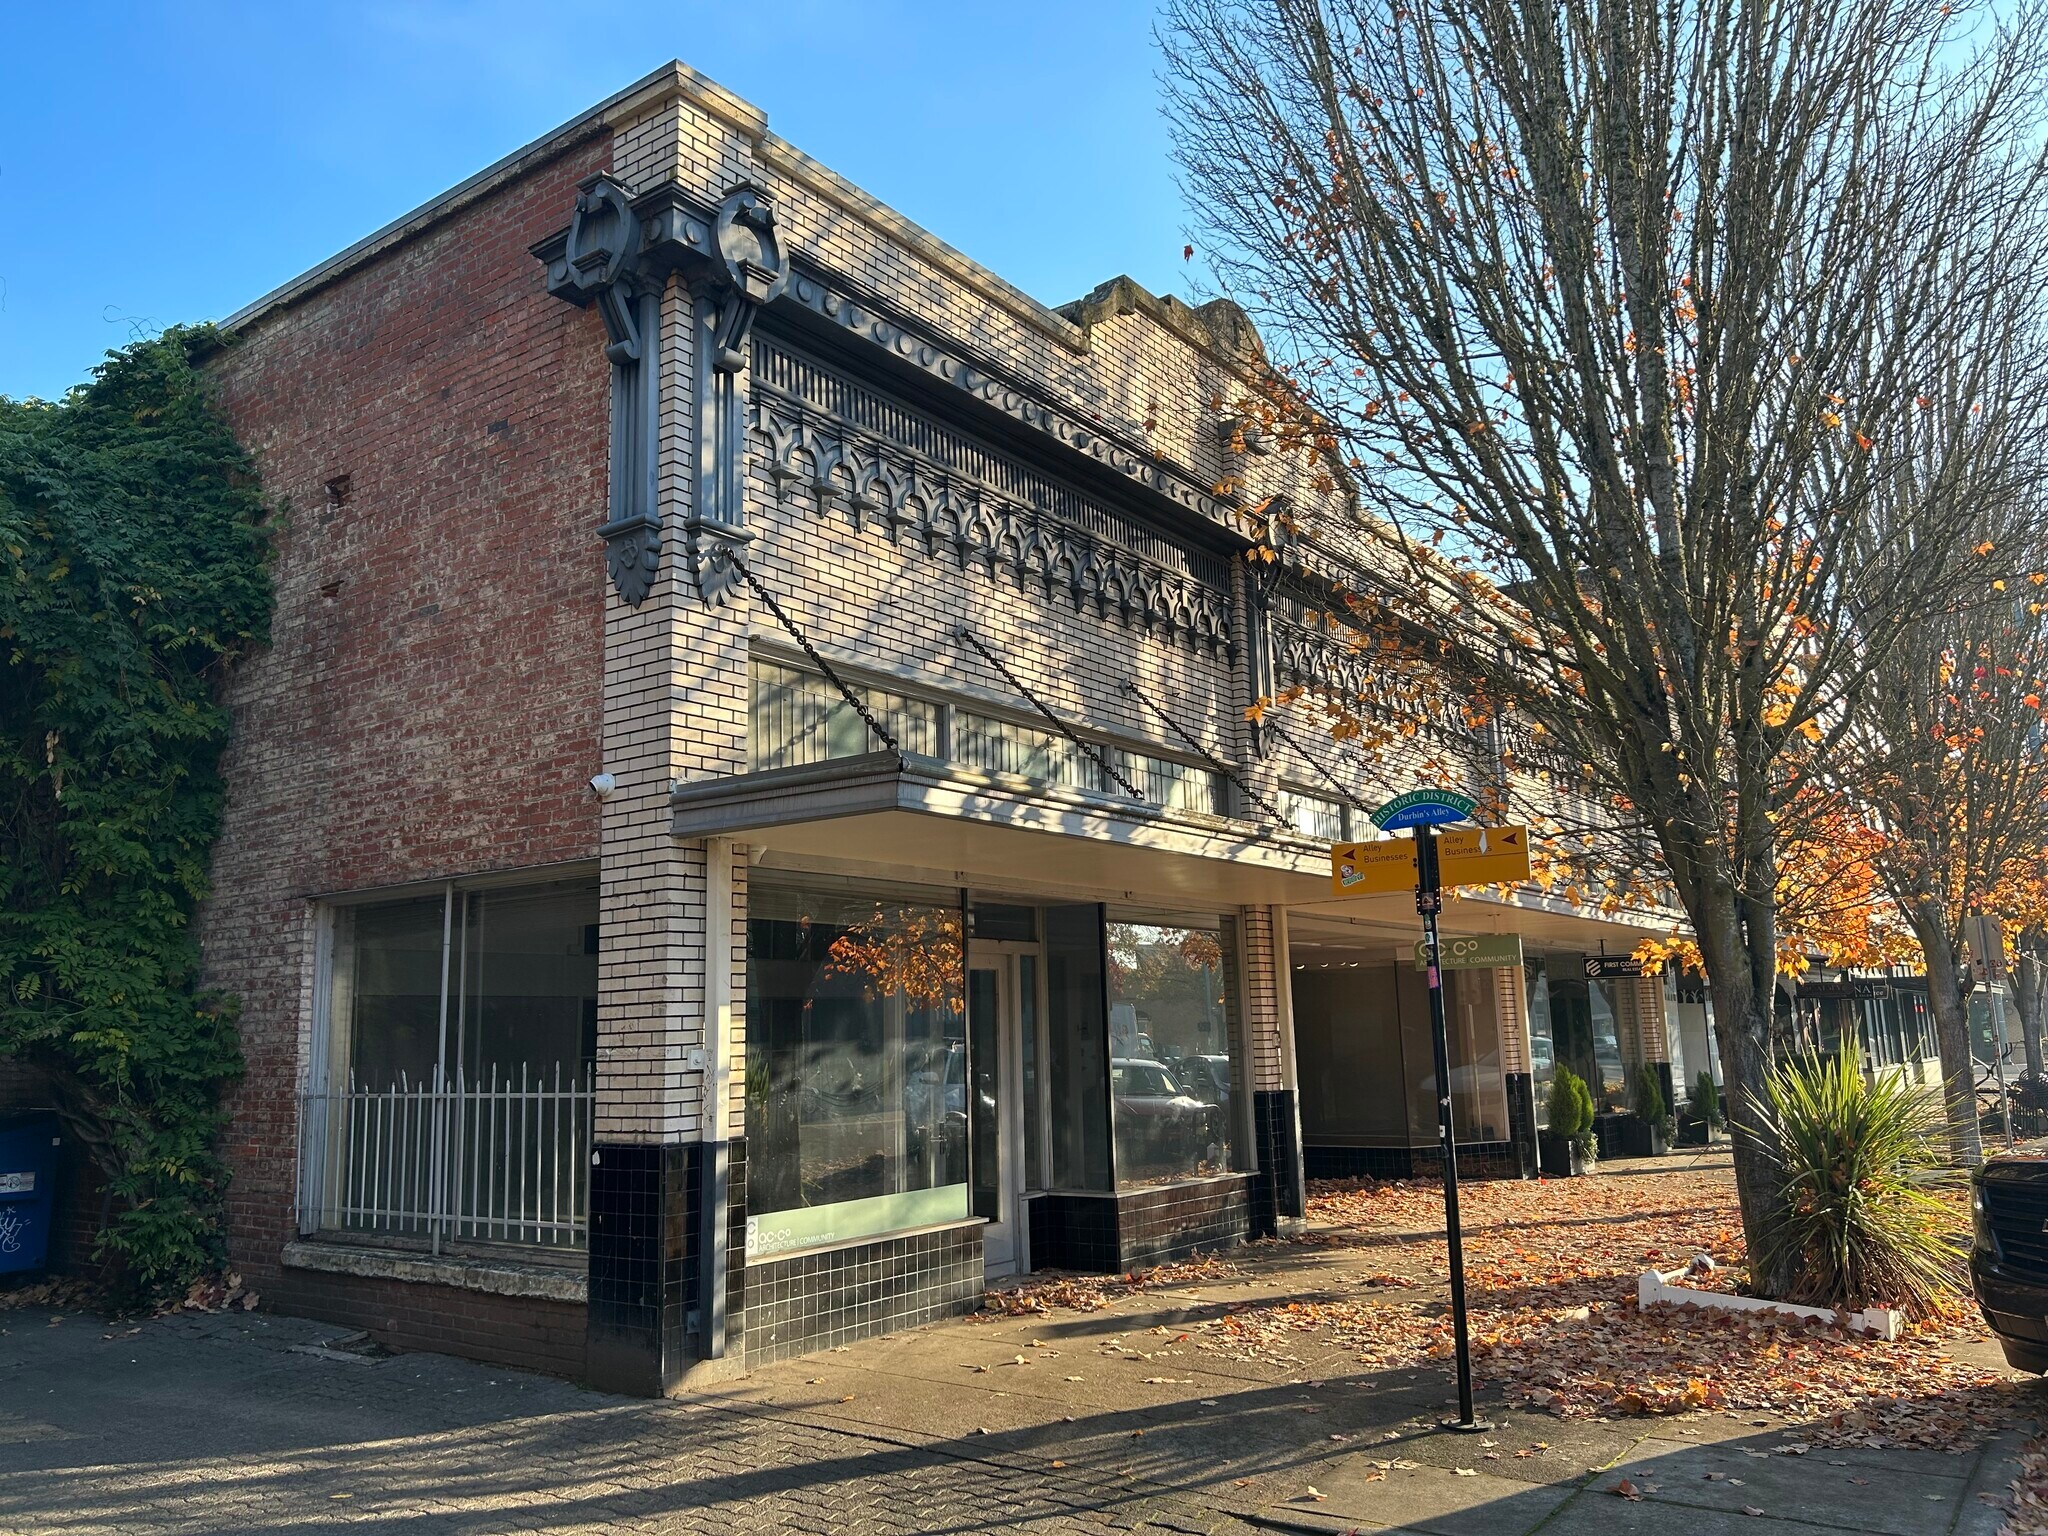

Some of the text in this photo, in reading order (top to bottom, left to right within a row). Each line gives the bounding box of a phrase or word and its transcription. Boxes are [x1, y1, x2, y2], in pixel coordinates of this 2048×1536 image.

[1374, 791, 1472, 824] HISTORIC DISTRICT
[1398, 808, 1449, 821] Durbin's Alley
[1444, 836, 1464, 844] Alley
[1363, 844, 1382, 852] Alley
[1445, 845, 1492, 856] Businesss
[1364, 853, 1408, 863] Businesses
[1420, 955, 1517, 966] ARECTURE COMMUNITY
[759, 1232, 835, 1252] ARCHITECTURE COMMUNITY
